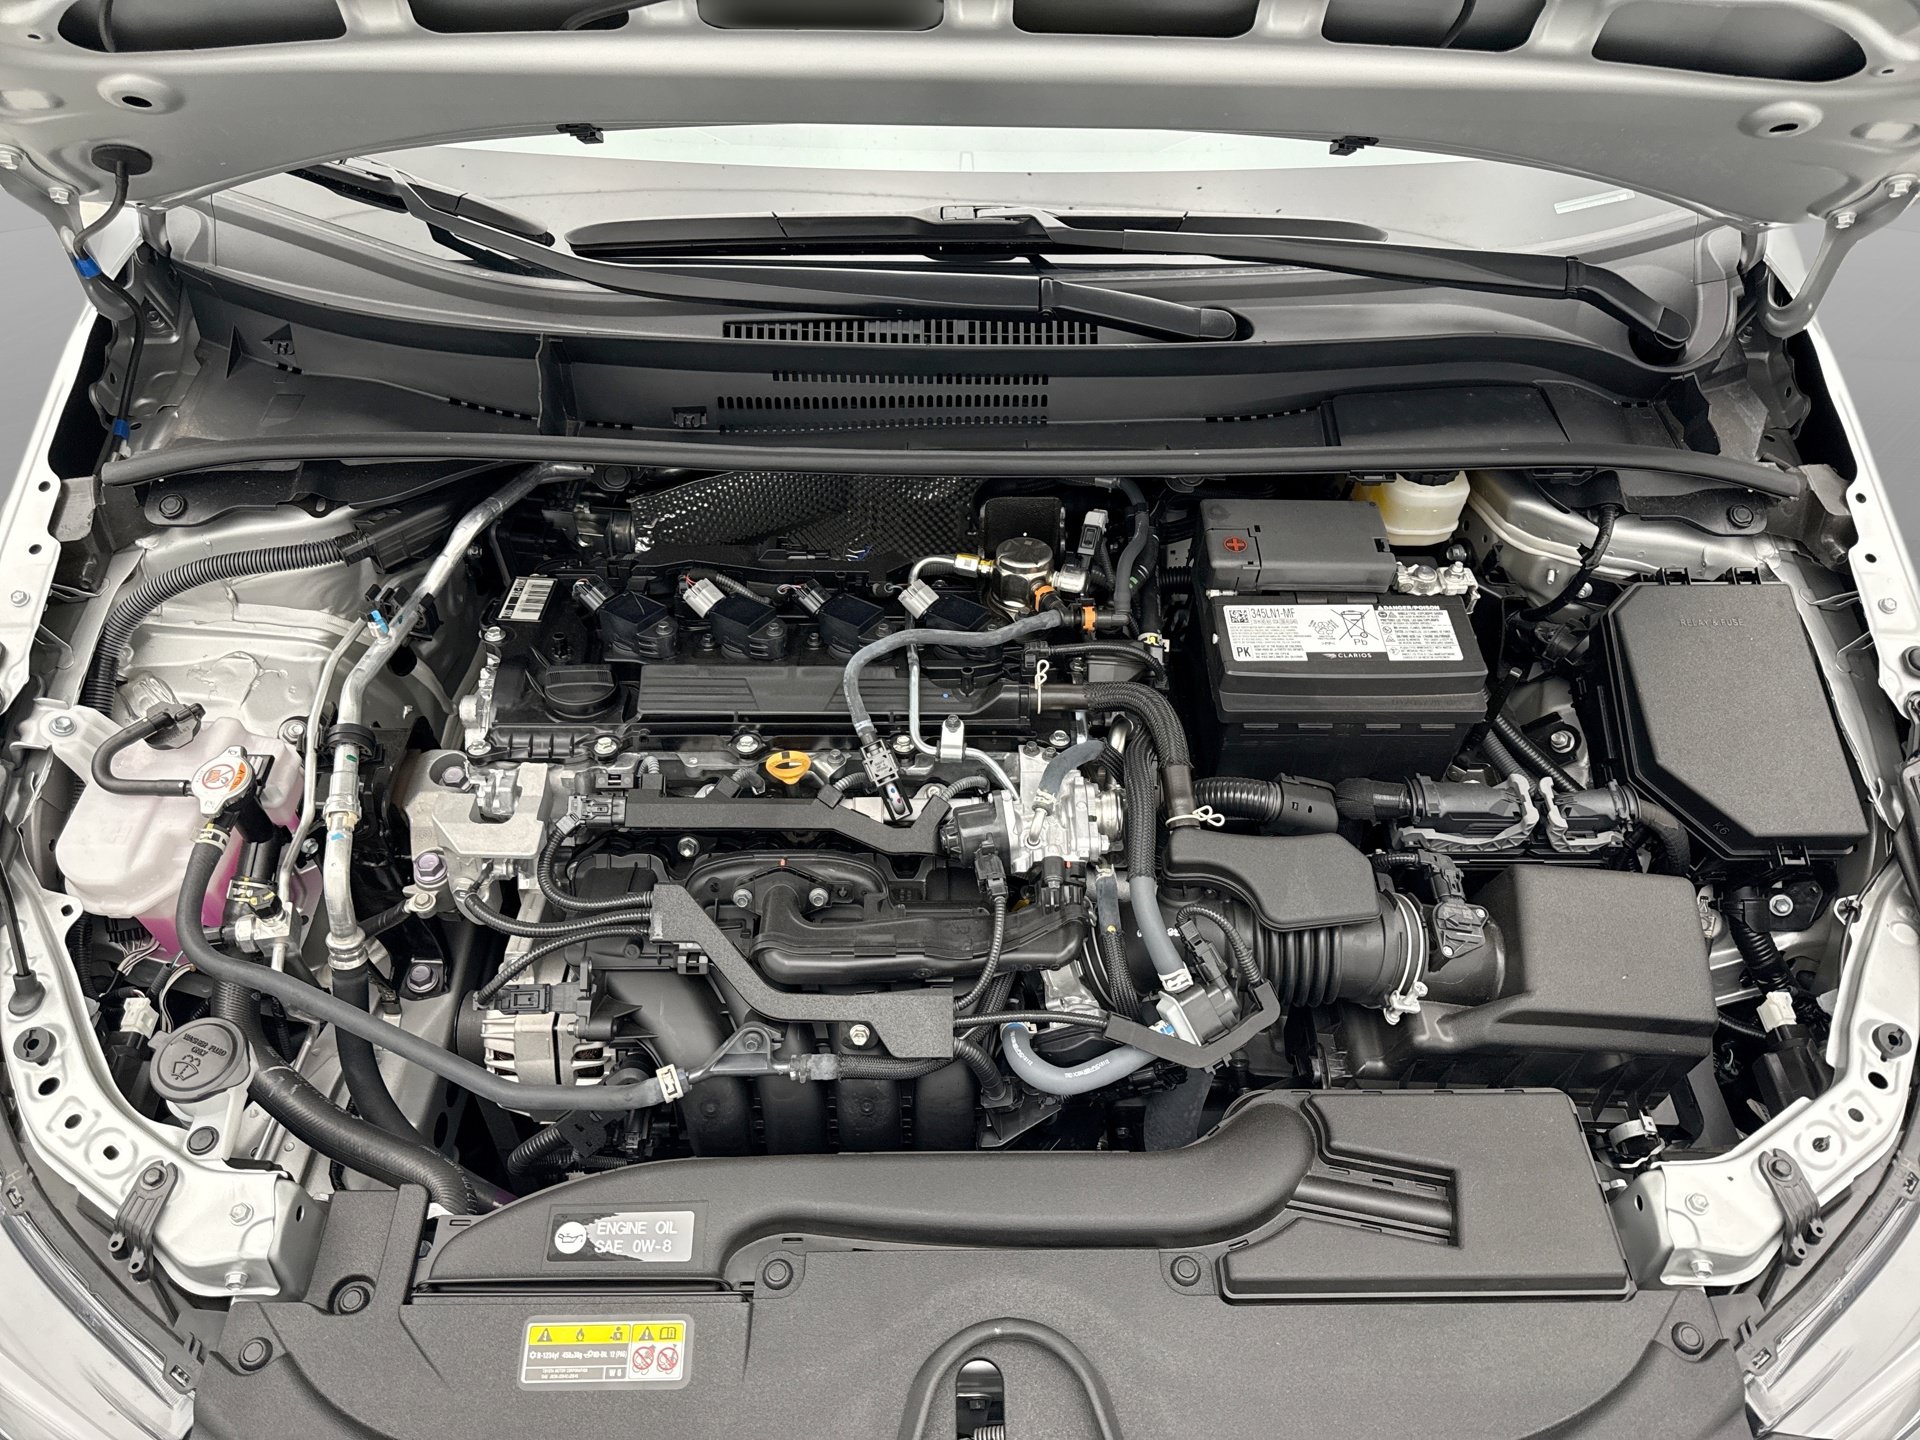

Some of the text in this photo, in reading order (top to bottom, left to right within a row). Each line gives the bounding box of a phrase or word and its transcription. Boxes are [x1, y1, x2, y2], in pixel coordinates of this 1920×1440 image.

[1250, 608, 1295, 618] 345LN1-MF
[1680, 618, 1708, 627] RELAY
[1720, 617, 1744, 627] FUSE
[1353, 638, 1368, 646] Pb
[1236, 646, 1251, 657] PK
[183, 1033, 227, 1057] WASHER FLUID
[191, 1046, 209, 1057] ONLY
[596, 1220, 678, 1235] ENGINE OIL
[594, 1239, 672, 1253] SAE 0W-8
